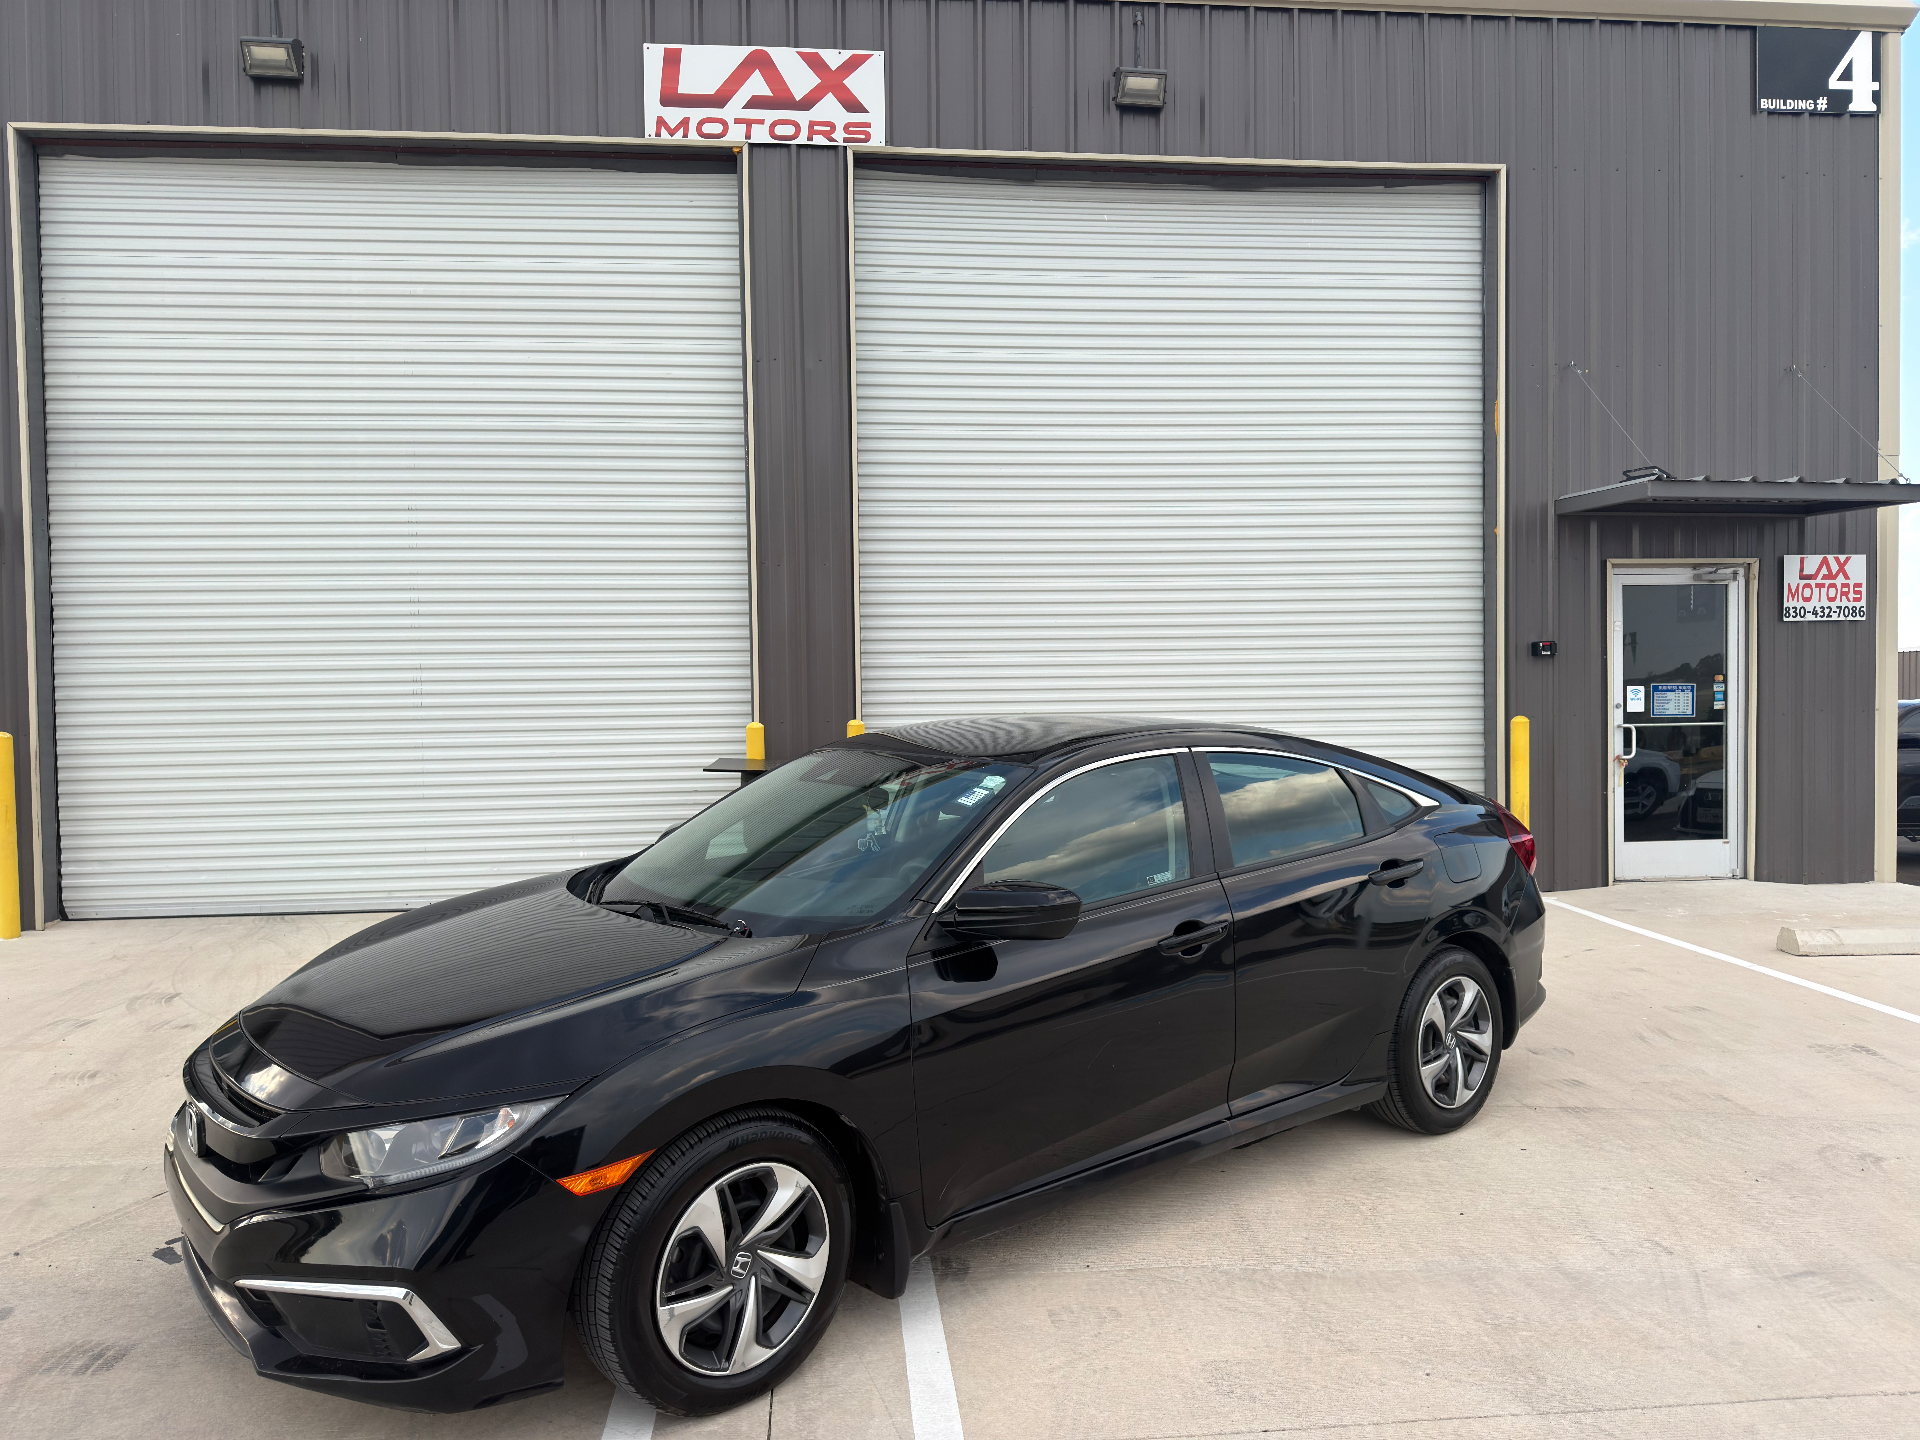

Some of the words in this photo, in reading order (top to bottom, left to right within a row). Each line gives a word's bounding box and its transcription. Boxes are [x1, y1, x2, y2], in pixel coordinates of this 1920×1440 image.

[659, 47, 875, 113] LAX
[1760, 98, 1815, 110] BUILDING
[1816, 96, 1828, 111] #
[1828, 30, 1880, 112] 4
[654, 115, 872, 143] MOTORS
[1798, 555, 1852, 580] LAX
[1786, 582, 1863, 603] MOTORS
[1783, 605, 1866, 619] 830-432-7086
